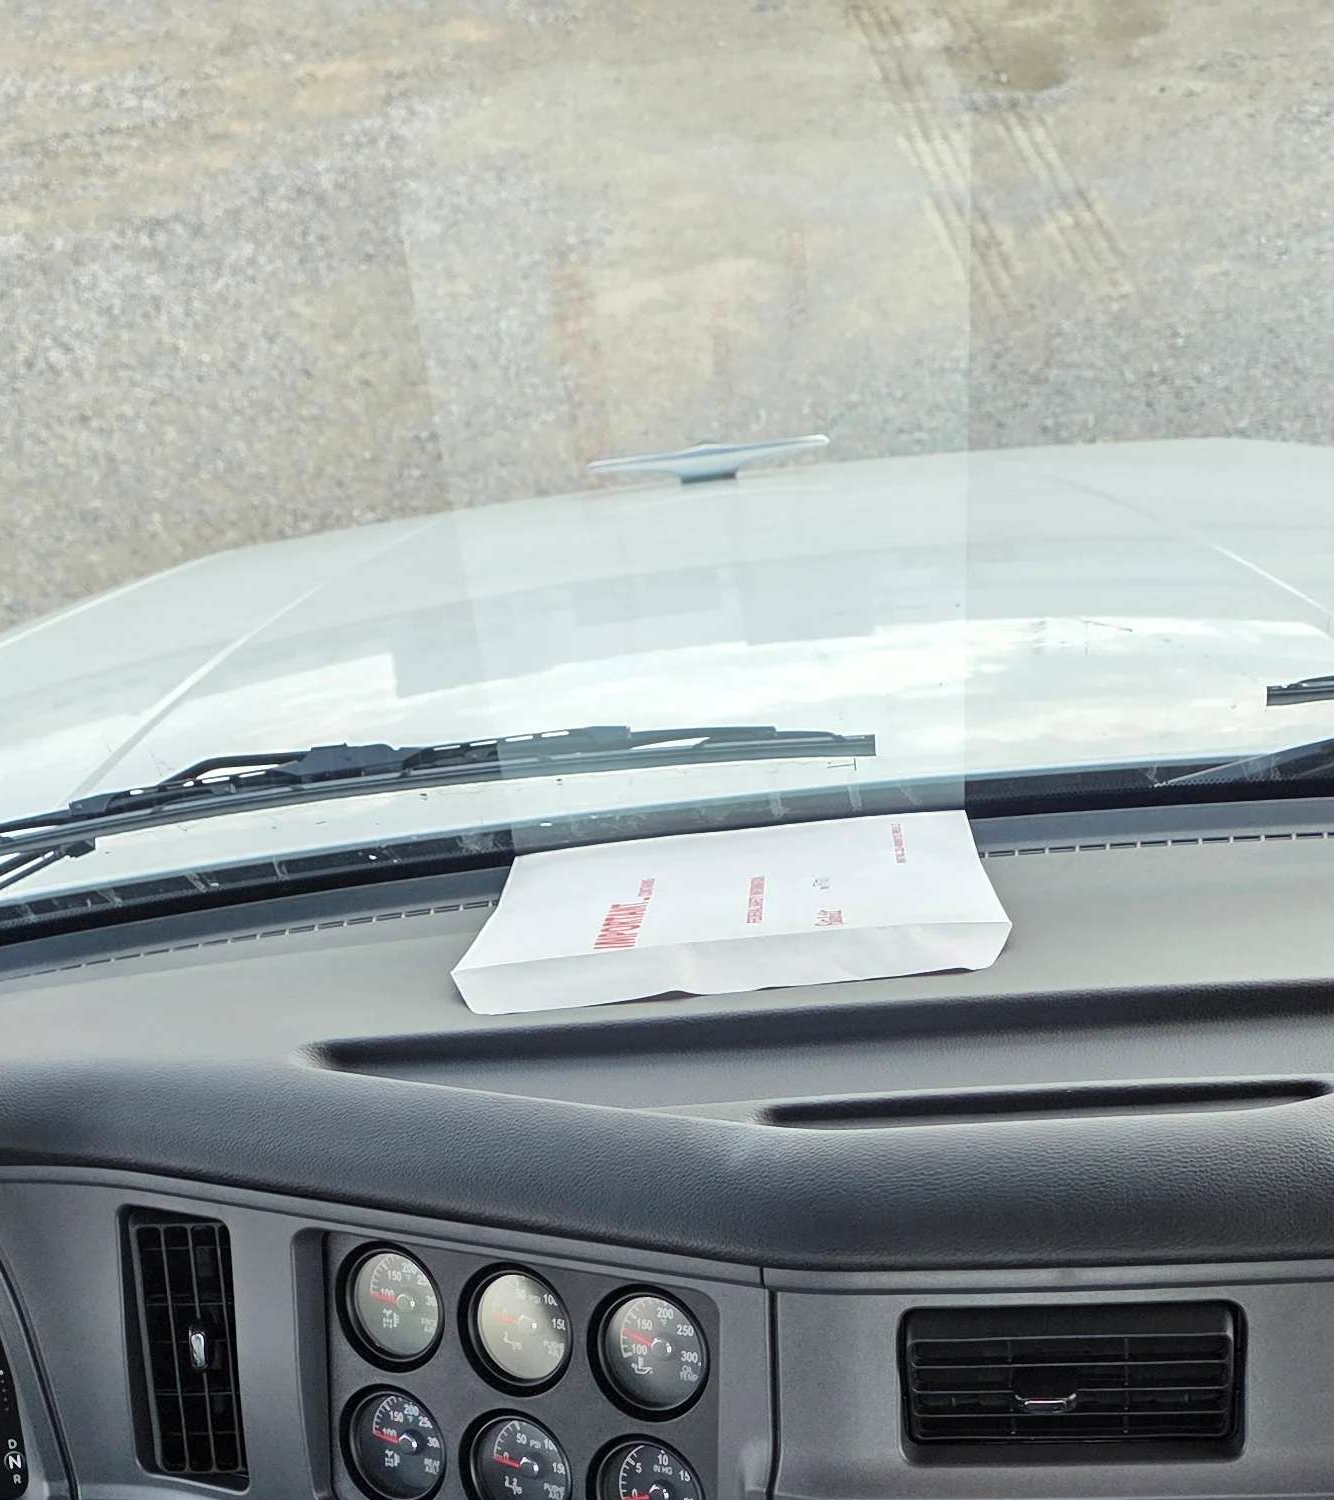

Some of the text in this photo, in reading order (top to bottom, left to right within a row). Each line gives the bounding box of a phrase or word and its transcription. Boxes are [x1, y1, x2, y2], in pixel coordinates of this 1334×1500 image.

[387, 1270, 403, 1282] 150
[656, 1306, 675, 1320] 200
[635, 1318, 653, 1331] 150
[676, 1323, 695, 1337] 250
[630, 1343, 648, 1356] 100
[680, 1350, 699, 1364] 300
[679, 1371, 699, 1382] TEMP
[389, 1410, 404, 1423] 150
[7, 1438, 18, 1450] D
[515, 1431, 527, 1445] 50
[529, 1439, 542, 1450] PSI
[8, 1454, 22, 1470] N
[657, 1453, 669, 1466] 10
[635, 1462, 643, 1474] 5
[13, 1474, 22, 1485] R
[679, 1469, 691, 1482] 15
